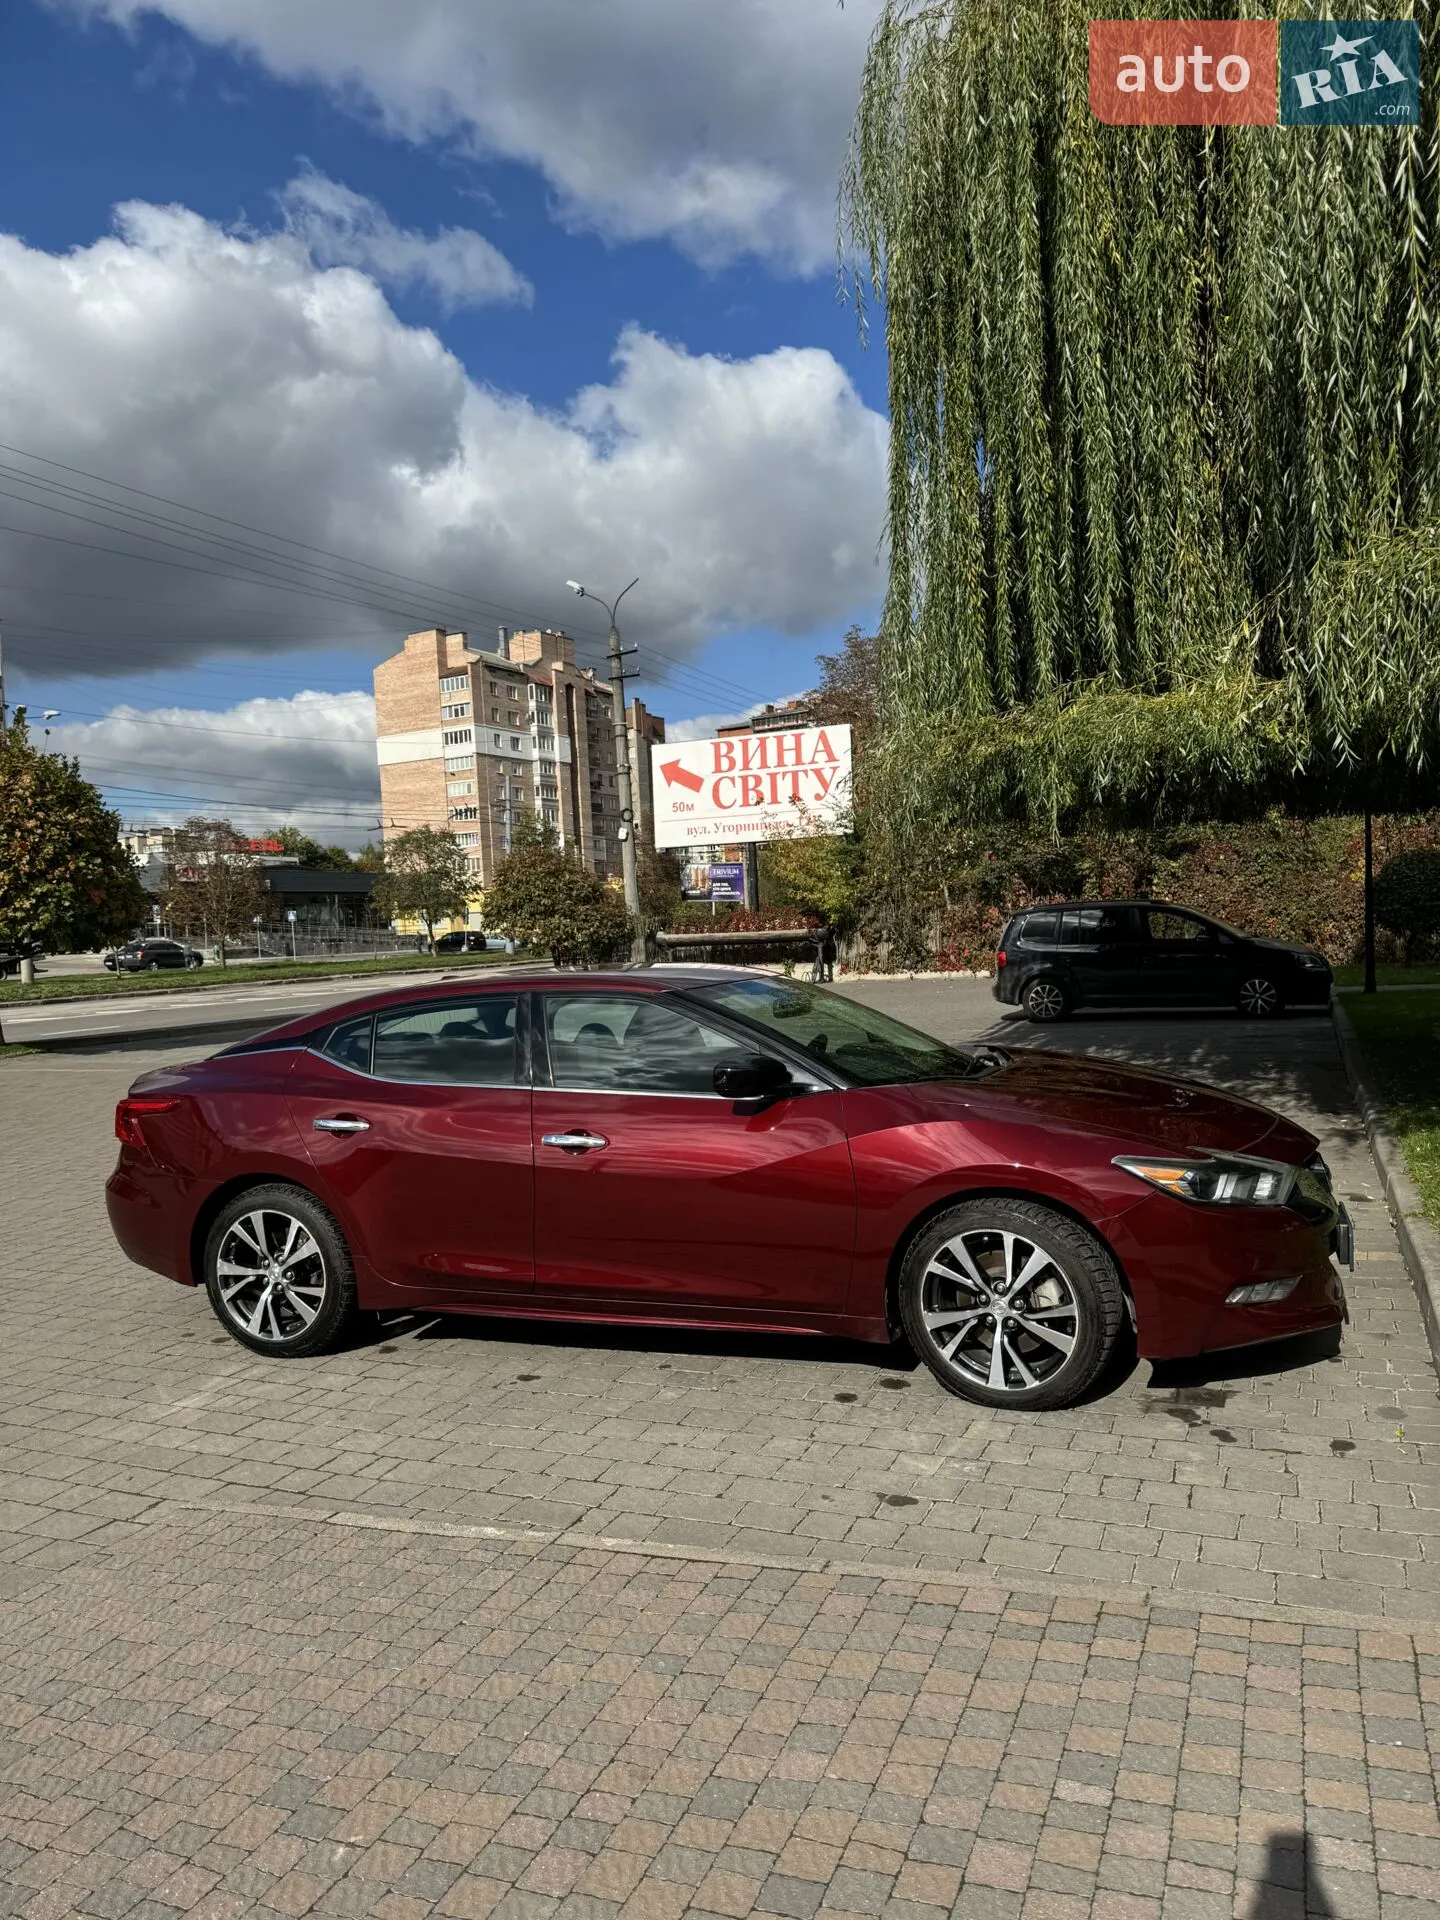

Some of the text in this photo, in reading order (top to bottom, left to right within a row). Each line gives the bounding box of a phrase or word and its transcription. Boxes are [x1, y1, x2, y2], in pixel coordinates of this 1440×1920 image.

[710, 729, 840, 774] ВИНА
[712, 765, 840, 810] СВІТУ
[672, 801, 695, 813] 50м
[687, 826, 711, 838] вул.
